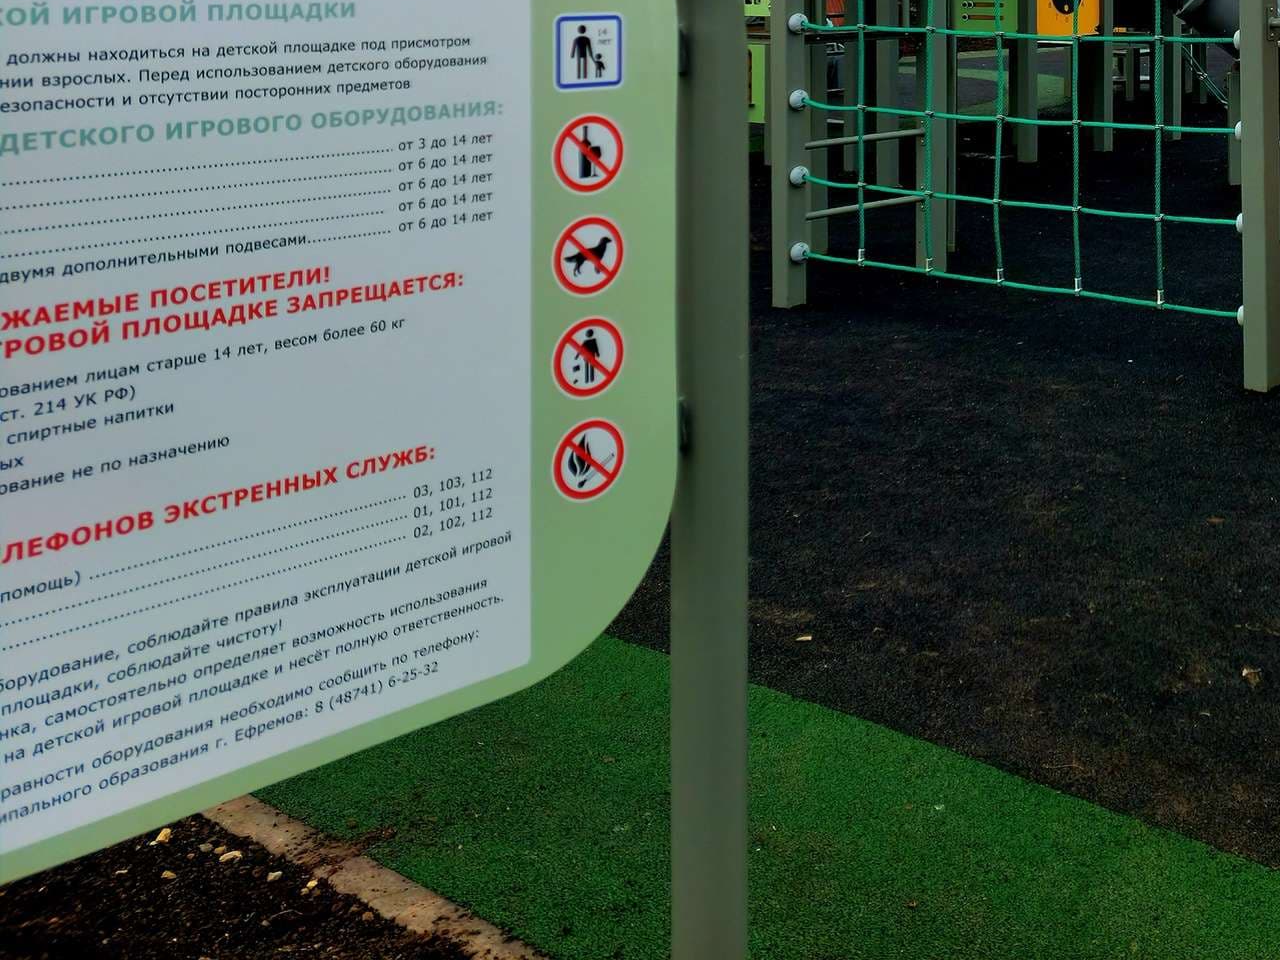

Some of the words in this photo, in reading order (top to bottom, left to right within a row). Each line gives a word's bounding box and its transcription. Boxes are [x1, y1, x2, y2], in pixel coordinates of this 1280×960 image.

[0, 2, 49, 26] ОЙ
[63, 0, 196, 25] ИГРОВОЙ
[208, 2, 355, 22] ПЛОЩАДКИ
[0, 77, 34, 89] нии
[41, 73, 131, 89] взрослых.
[139, 68, 190, 84] Перед
[196, 64, 322, 80] использованием
[326, 60, 390, 75] детского
[394, 56, 487, 71] оборудования
[6, 51, 80, 67] должны
[88, 47, 185, 63] находиться
[192, 46, 210, 57] на
[216, 40, 277, 58] детской
[284, 41, 356, 54] площадке
[361, 40, 386, 52] под
[391, 38, 471, 52] присмотром
[0, 96, 115, 113] езопасности
[122, 95, 132, 106] и
[139, 90, 229, 107] отсутствии
[235, 84, 332, 100] посторонних
[336, 80, 411, 95] предметов
[0, 124, 154, 157] ДЕТСКОГО
[166, 114, 302, 140] ИГРОВОГО
[311, 101, 502, 129] ОБОРУДОВАНИЯ:
[398, 141, 414, 151] от
[418, 137, 426, 150] 3
[430, 138, 447, 150] до
[453, 134, 467, 146] 14
[471, 134, 493, 144] лет
[398, 161, 414, 172] от
[418, 157, 426, 169] 6
[430, 158, 447, 170] до
[453, 154, 467, 166] 14
[471, 153, 493, 164] лет
[398, 181, 414, 192] от
[418, 177, 426, 190] 6
[430, 177, 447, 190] до
[452, 173, 467, 186] 14
[471, 173, 493, 184] лет
[398, 201, 414, 212] от
[418, 197, 426, 210] 6
[430, 197, 447, 209] до
[453, 193, 467, 205] 14
[471, 192, 493, 203] лет
[0, 266, 55, 284] двумя
[61, 245, 219, 277] дополнительными
[398, 221, 414, 232] от
[418, 217, 426, 229] 6
[430, 217, 447, 230] до
[453, 212, 467, 225] 14
[471, 211, 493, 222] лет
[0, 293, 139, 331] ЖАЕМЫЕ
[150, 266, 330, 309] ПОСЕТИТЕЛИ!
[0, 319, 110, 359] РОВОЙ
[122, 299, 278, 340] ПЛОЩАДКЕ
[286, 272, 463, 314] ЗАПРЕЩАЕТСЯ:
[0, 375, 78, 398] ованием
[85, 364, 140, 383] лицам
[146, 352, 207, 373] старше
[214, 346, 231, 360] 14
[237, 343, 268, 357] лет,
[274, 333, 318, 350] весом
[323, 325, 365, 342] более
[370, 319, 387, 333] 60
[391, 318, 405, 330] кг
[0, 409, 25, 423] ст.
[33, 398, 67, 416] 214
[74, 392, 97, 408] УК
[104, 385, 136, 403] РФ)
[6, 418, 97, 445] спиртные
[104, 403, 174, 426] напитки
[0, 456, 24, 471] ых
[0, 472, 65, 495] ование
[72, 465, 94, 480] не
[100, 459, 122, 473] по
[129, 436, 230, 467] назначению
[413, 484, 433, 499] 03,
[440, 476, 465, 492] 103,
[472, 468, 493, 484] 112
[0, 511, 154, 564] ЛЕФОНОВ
[164, 466, 338, 524] ЭКСТРЕННЫХ
[346, 445, 435, 479] СЛУЖБ:
[413, 504, 433, 519] 01,
[440, 496, 465, 512] 101,
[471, 487, 492, 503] 112
[413, 524, 433, 539] 02,
[440, 515, 465, 532] 102,
[472, 507, 493, 523] 112
[0, 570, 81, 604] помощь)
[127, 616, 229, 654] соблюдайте
[235, 595, 298, 622] правила
[304, 565, 400, 602] эксплуатации
[405, 545, 457, 574] детской
[462, 530, 512, 556] игровой
[1, 679, 100, 717] площадки,
[107, 643, 210, 684] соблюдайте
[216, 618, 282, 648] чистоту!
[44, 672, 187, 727] самостоятельно
[193, 641, 286, 679] определяет
[292, 612, 385, 648] возможность
[390, 579, 487, 617] использования
[4, 748, 25, 764] на
[32, 719, 105, 757] детской
[112, 693, 182, 729] игровой
[188, 669, 269, 703] площадке
[274, 664, 283, 676] и
[289, 648, 331, 670] несёт
[335, 630, 388, 655] полную
[393, 596, 504, 637] ответственность.
[0, 763, 85, 803] равности
[91, 719, 214, 769] оборудования
[220, 685, 313, 725] необходимо
[318, 662, 387, 691] сообщить
[392, 653, 408, 667] по
[413, 629, 479, 659] телефону:
[98, 743, 209, 790] образования
[215, 738, 227, 749] г.
[235, 708, 308, 742] Ефремов:
[314, 700, 324, 714] 8
[329, 679, 383, 711] (48741)
[388, 661, 438, 688] 6-25-32
